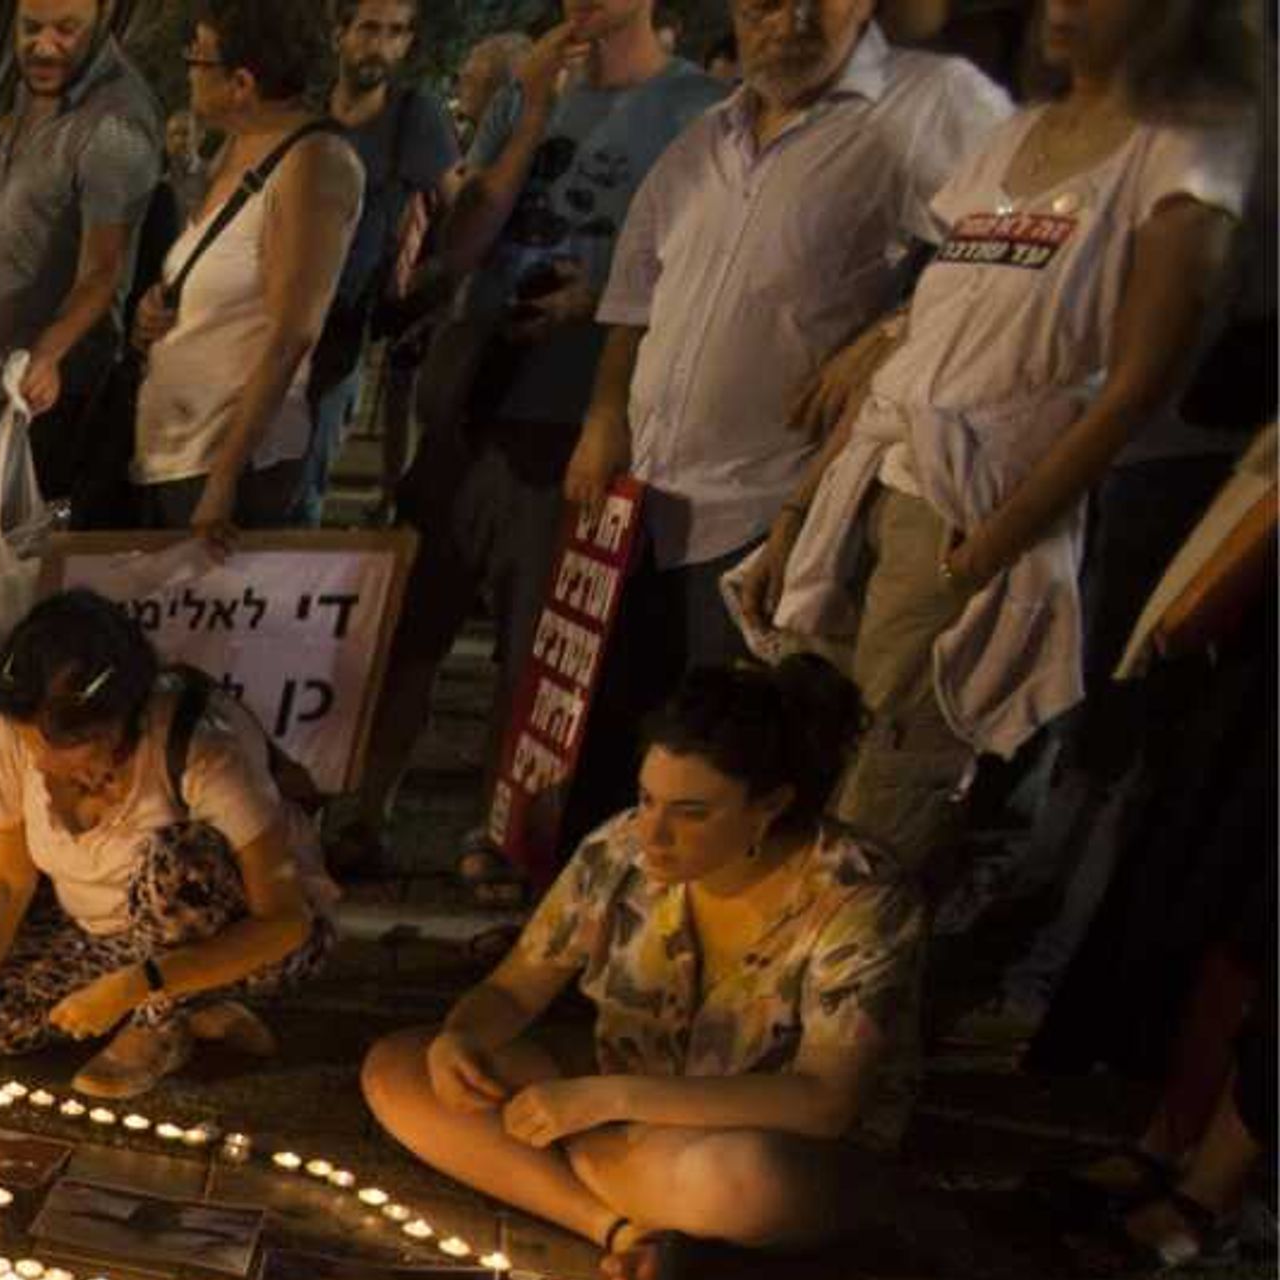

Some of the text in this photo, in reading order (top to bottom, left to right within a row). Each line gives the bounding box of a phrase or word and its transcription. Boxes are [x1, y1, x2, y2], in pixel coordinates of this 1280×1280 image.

[120, 587, 359, 638] די לאלימ
[274, 679, 335, 737] כן
